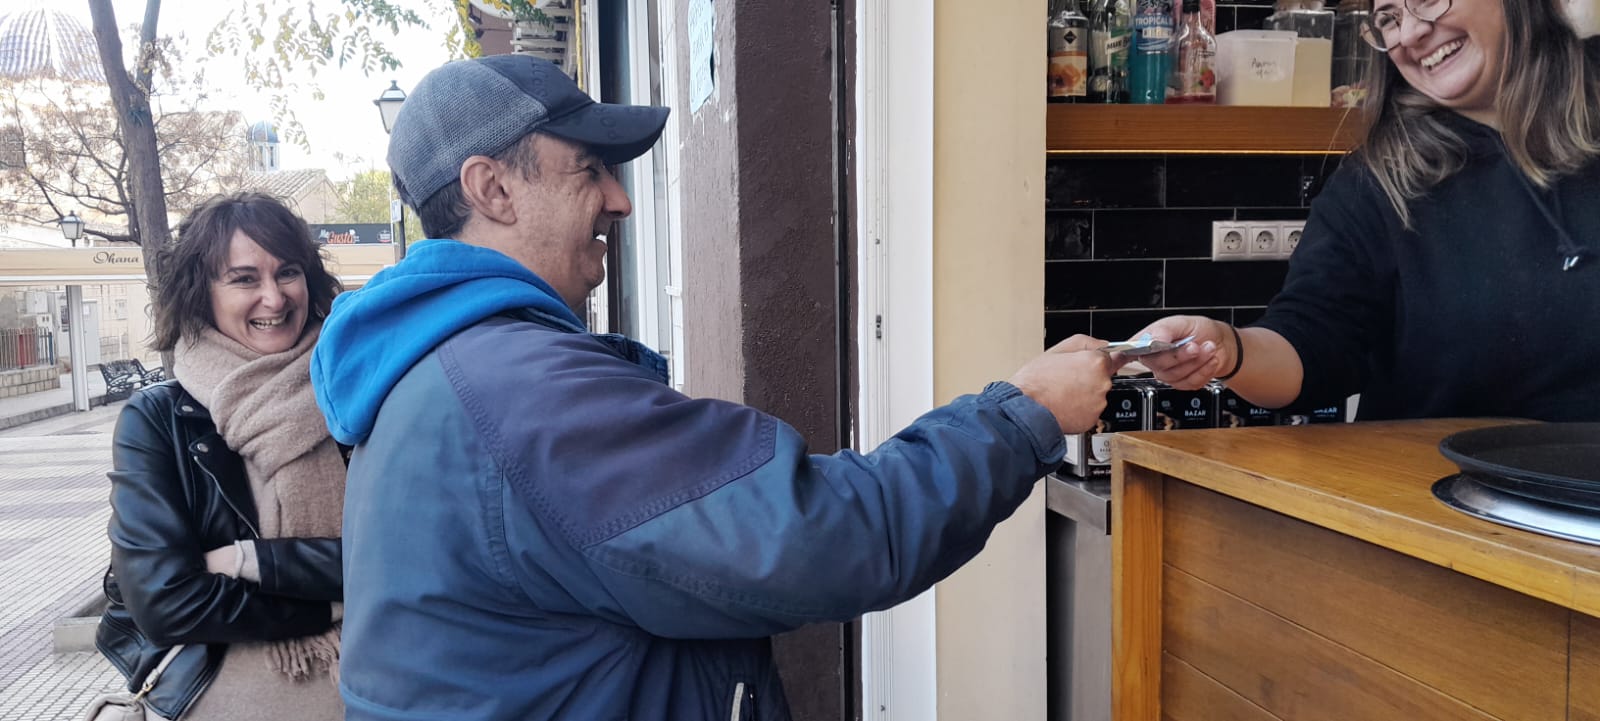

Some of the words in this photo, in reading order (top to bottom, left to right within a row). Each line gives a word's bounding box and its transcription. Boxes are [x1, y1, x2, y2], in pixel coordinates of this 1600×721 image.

[1135, 15, 1168, 27] TROPICAL
[327, 231, 353, 244] Gusto
[93, 251, 139, 264] Ohana
